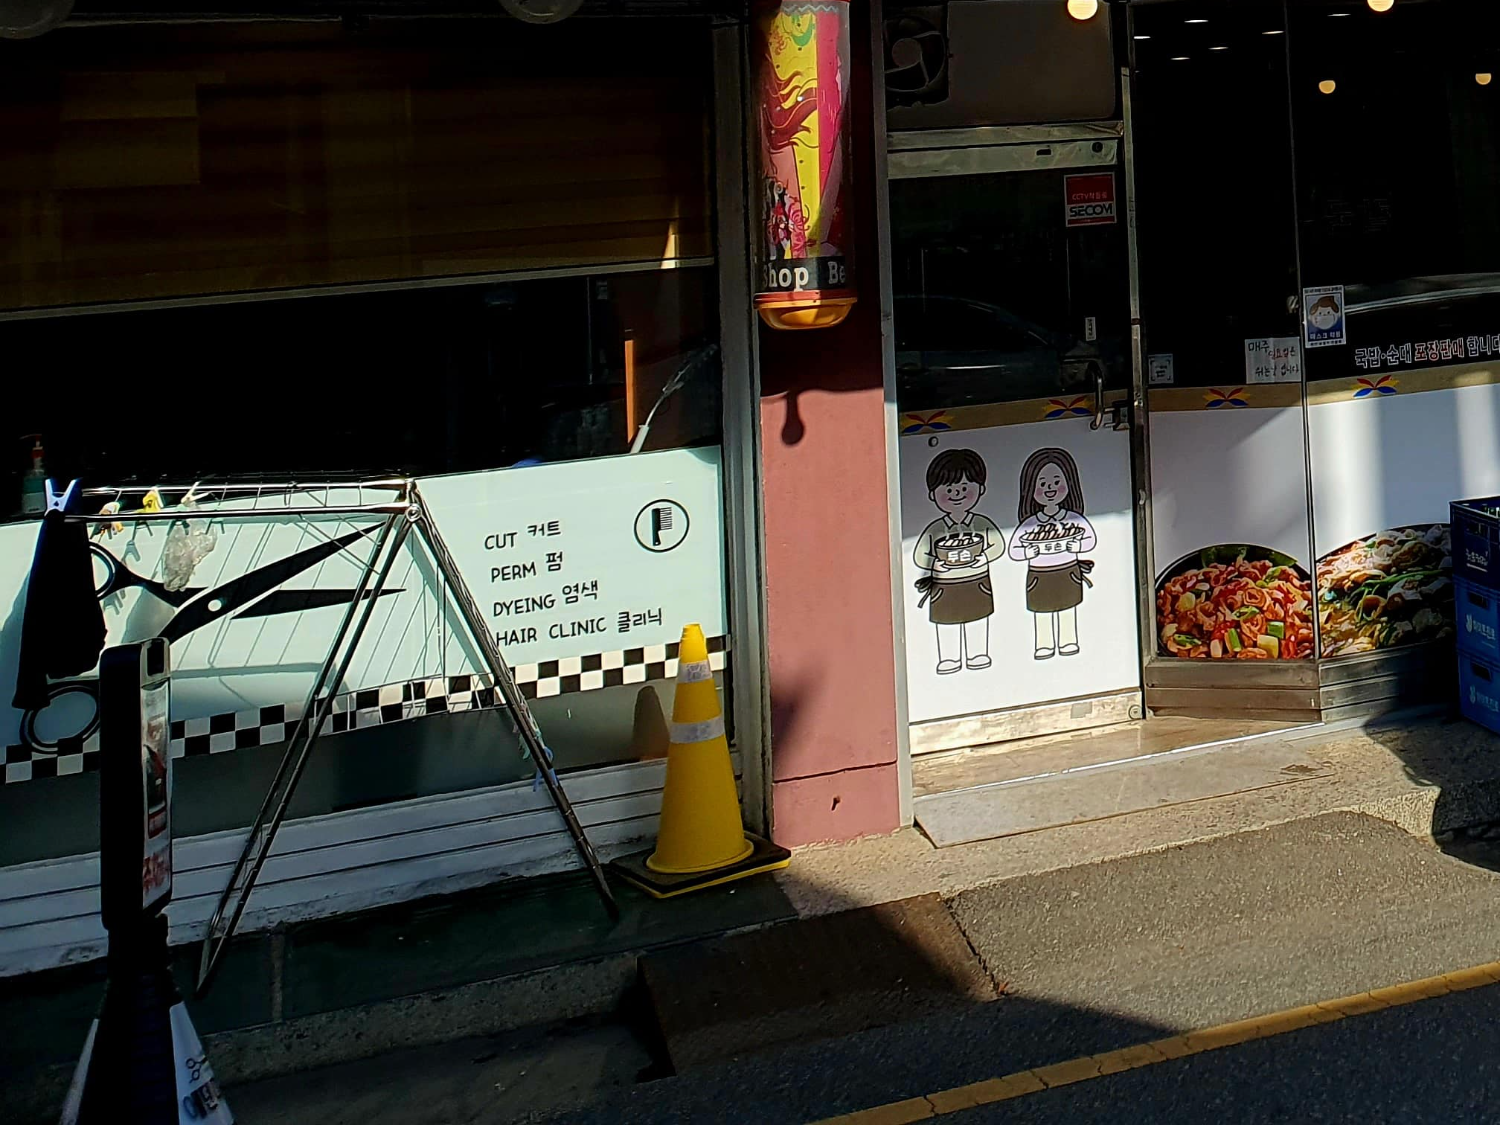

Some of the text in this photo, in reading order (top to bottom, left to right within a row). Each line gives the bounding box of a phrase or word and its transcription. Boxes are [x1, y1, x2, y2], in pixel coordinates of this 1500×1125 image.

[1069, 203, 1113, 217] SECOM
[1248, 340, 1270, 353] 매주
[1414, 336, 1465, 363] 포장판매
[484, 520, 562, 551] CUT 커트
[491, 552, 563, 583] PERM 펌
[947, 549, 972, 563] 두손
[493, 580, 599, 617] DYEING 염색
[496, 608, 663, 648] HAIR CLINIC 클리닉
